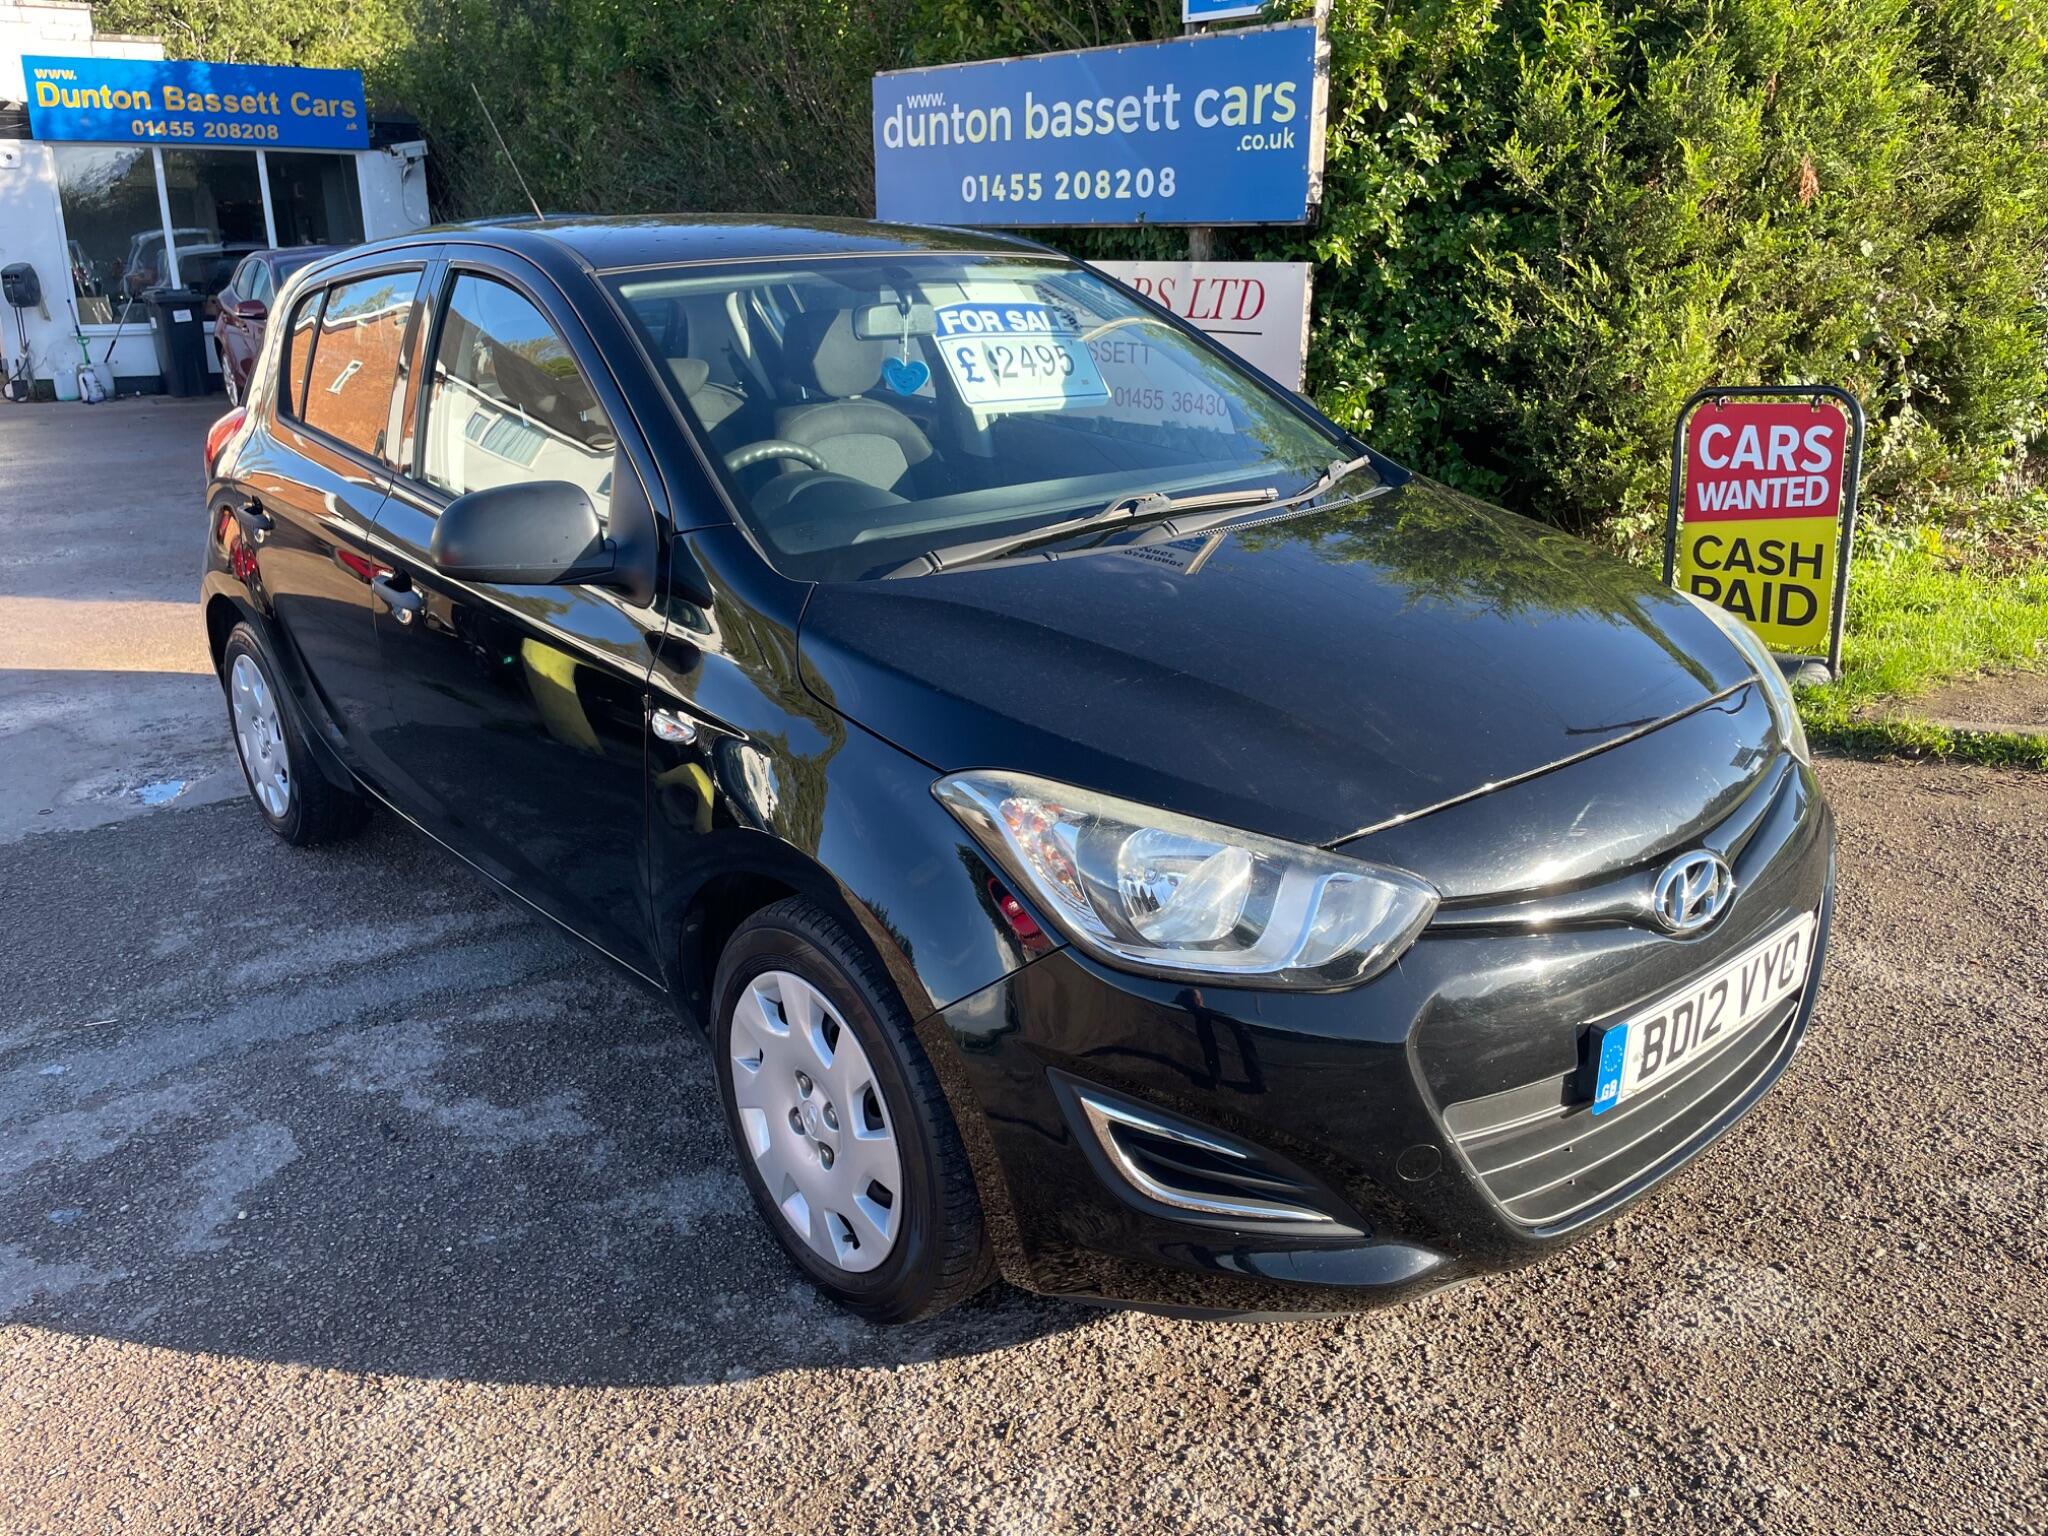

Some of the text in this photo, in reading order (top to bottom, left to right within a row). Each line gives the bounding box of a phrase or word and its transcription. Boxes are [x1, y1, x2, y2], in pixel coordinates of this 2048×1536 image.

[34, 68, 77, 80] www.
[35, 81, 357, 118] Dunton Bassett Cars
[883, 81, 1297, 149] dunton bassett cars
[906, 92, 946, 109] www.
[132, 120, 279, 140] 01455 208208
[1236, 127, 1295, 151] .co.uk
[962, 166, 1176, 203] 01455 208208
[1183, 278, 1266, 321] LTD
[939, 310, 1005, 334] FOR
[956, 344, 1075, 383] £ 2495
[1114, 386, 1164, 411] 01455
[1699, 423, 1834, 473] CARS
[1697, 475, 1829, 512] WANTED
[1692, 535, 1824, 579] CASH
[1690, 574, 1818, 626] PAID
[1637, 979, 1729, 1083] BD12
[1602, 1079, 1617, 1099] GB
